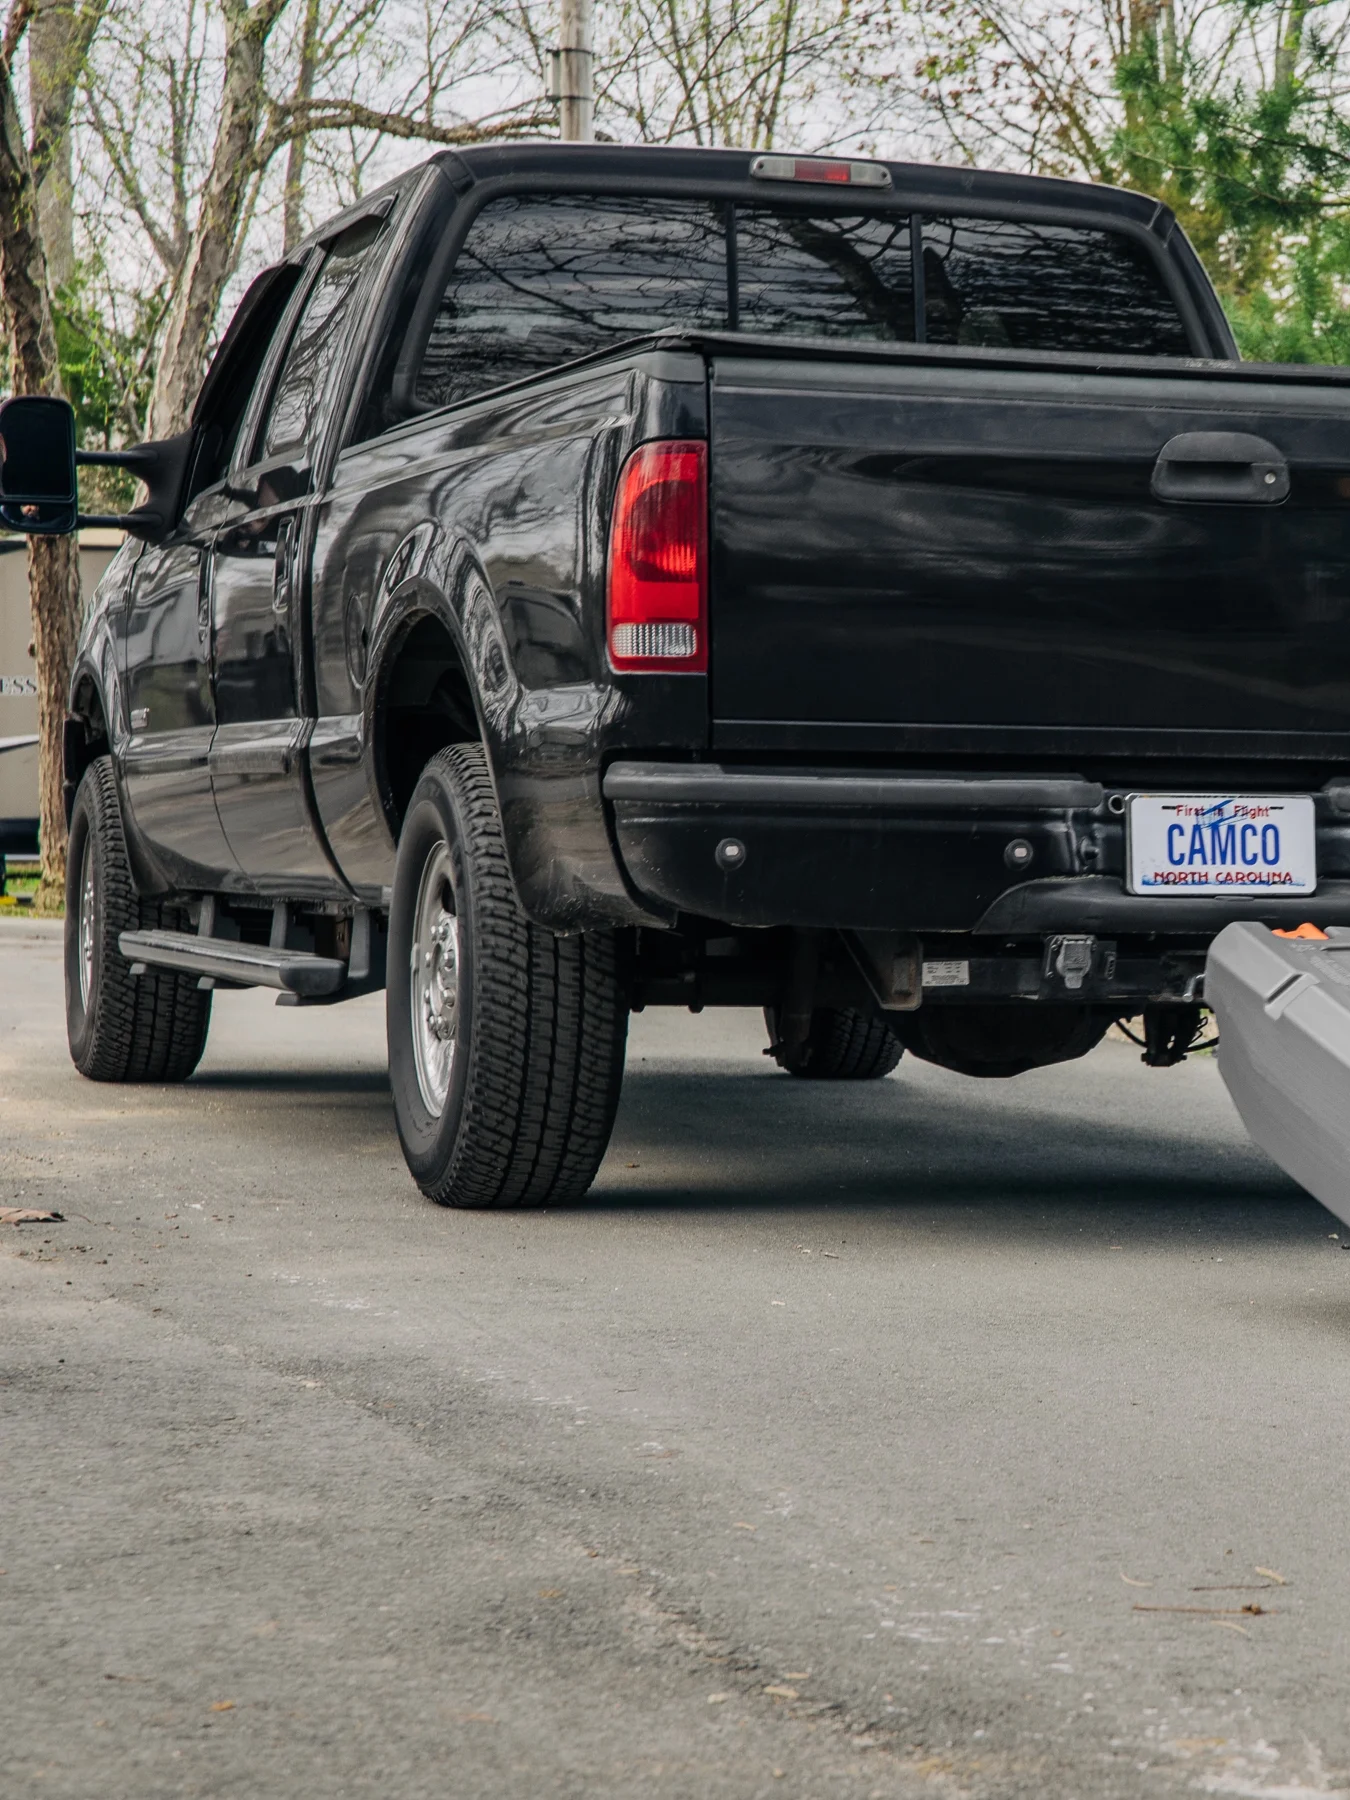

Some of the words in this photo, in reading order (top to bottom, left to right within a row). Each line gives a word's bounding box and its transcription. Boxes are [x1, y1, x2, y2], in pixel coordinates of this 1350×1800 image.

[1176, 804, 1205, 817] First
[1234, 805, 1270, 819] Flight
[1167, 823, 1280, 866] CAMCO
[1154, 872, 1209, 884] NORTH
[1215, 872, 1293, 884] CAROLINA
